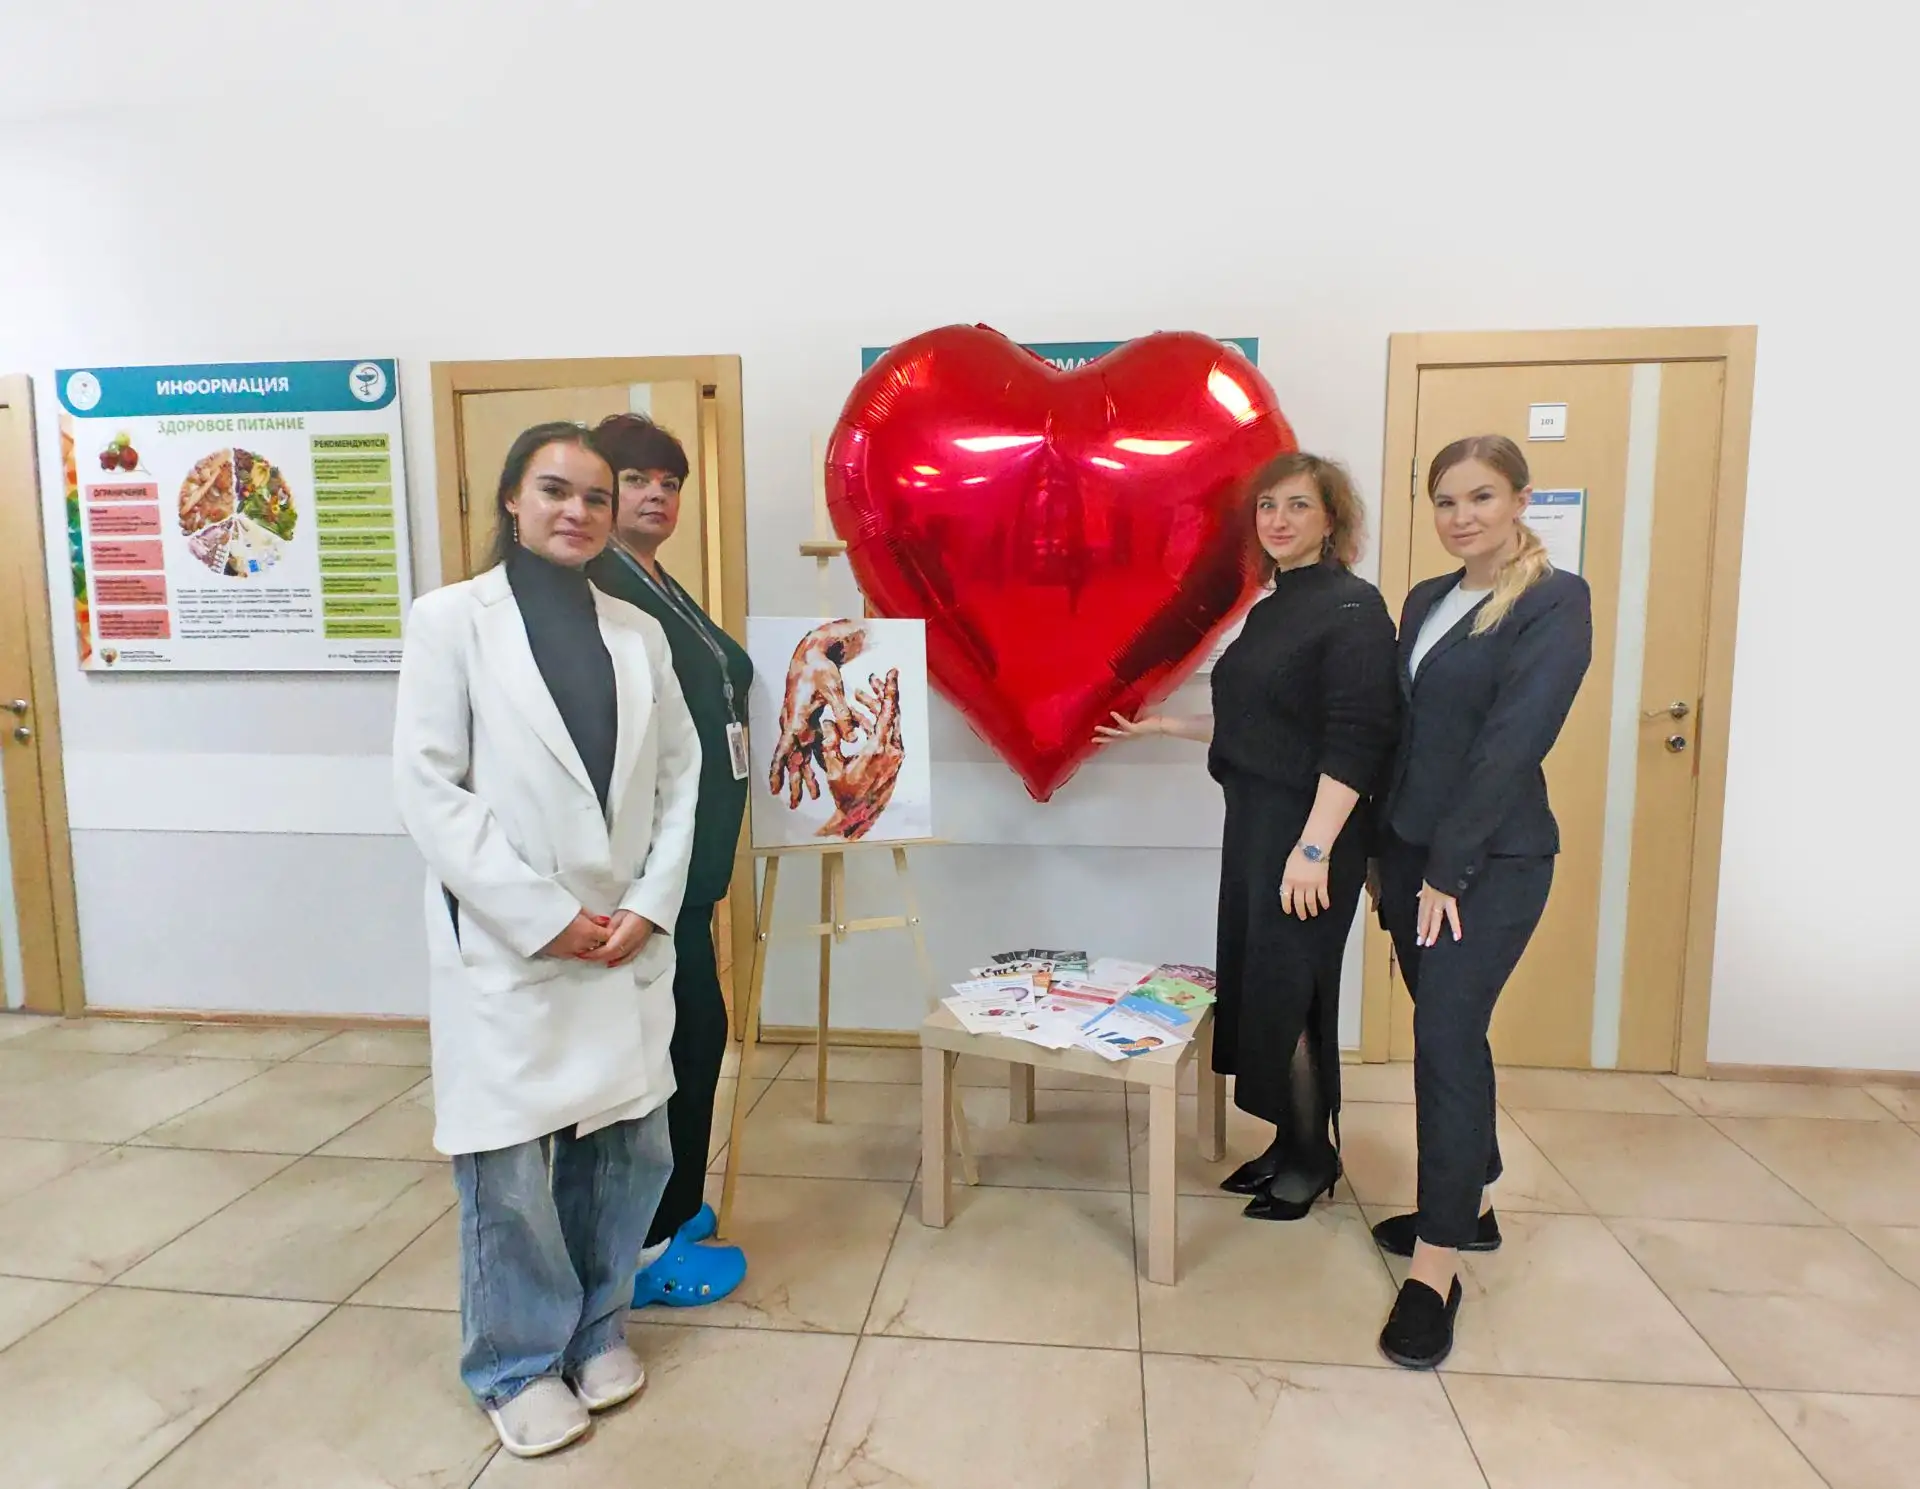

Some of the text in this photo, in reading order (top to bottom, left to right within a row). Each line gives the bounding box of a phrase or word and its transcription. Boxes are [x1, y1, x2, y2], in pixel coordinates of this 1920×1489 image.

[156, 377, 289, 396] ИНФОРМАЦИЯ
[157, 416, 305, 435] ЗДОРОВОЕ ПИТАНИЕ
[1541, 418, 1554, 426] 101
[313, 438, 386, 449] РЕКОМЕНДУЮТСЯ
